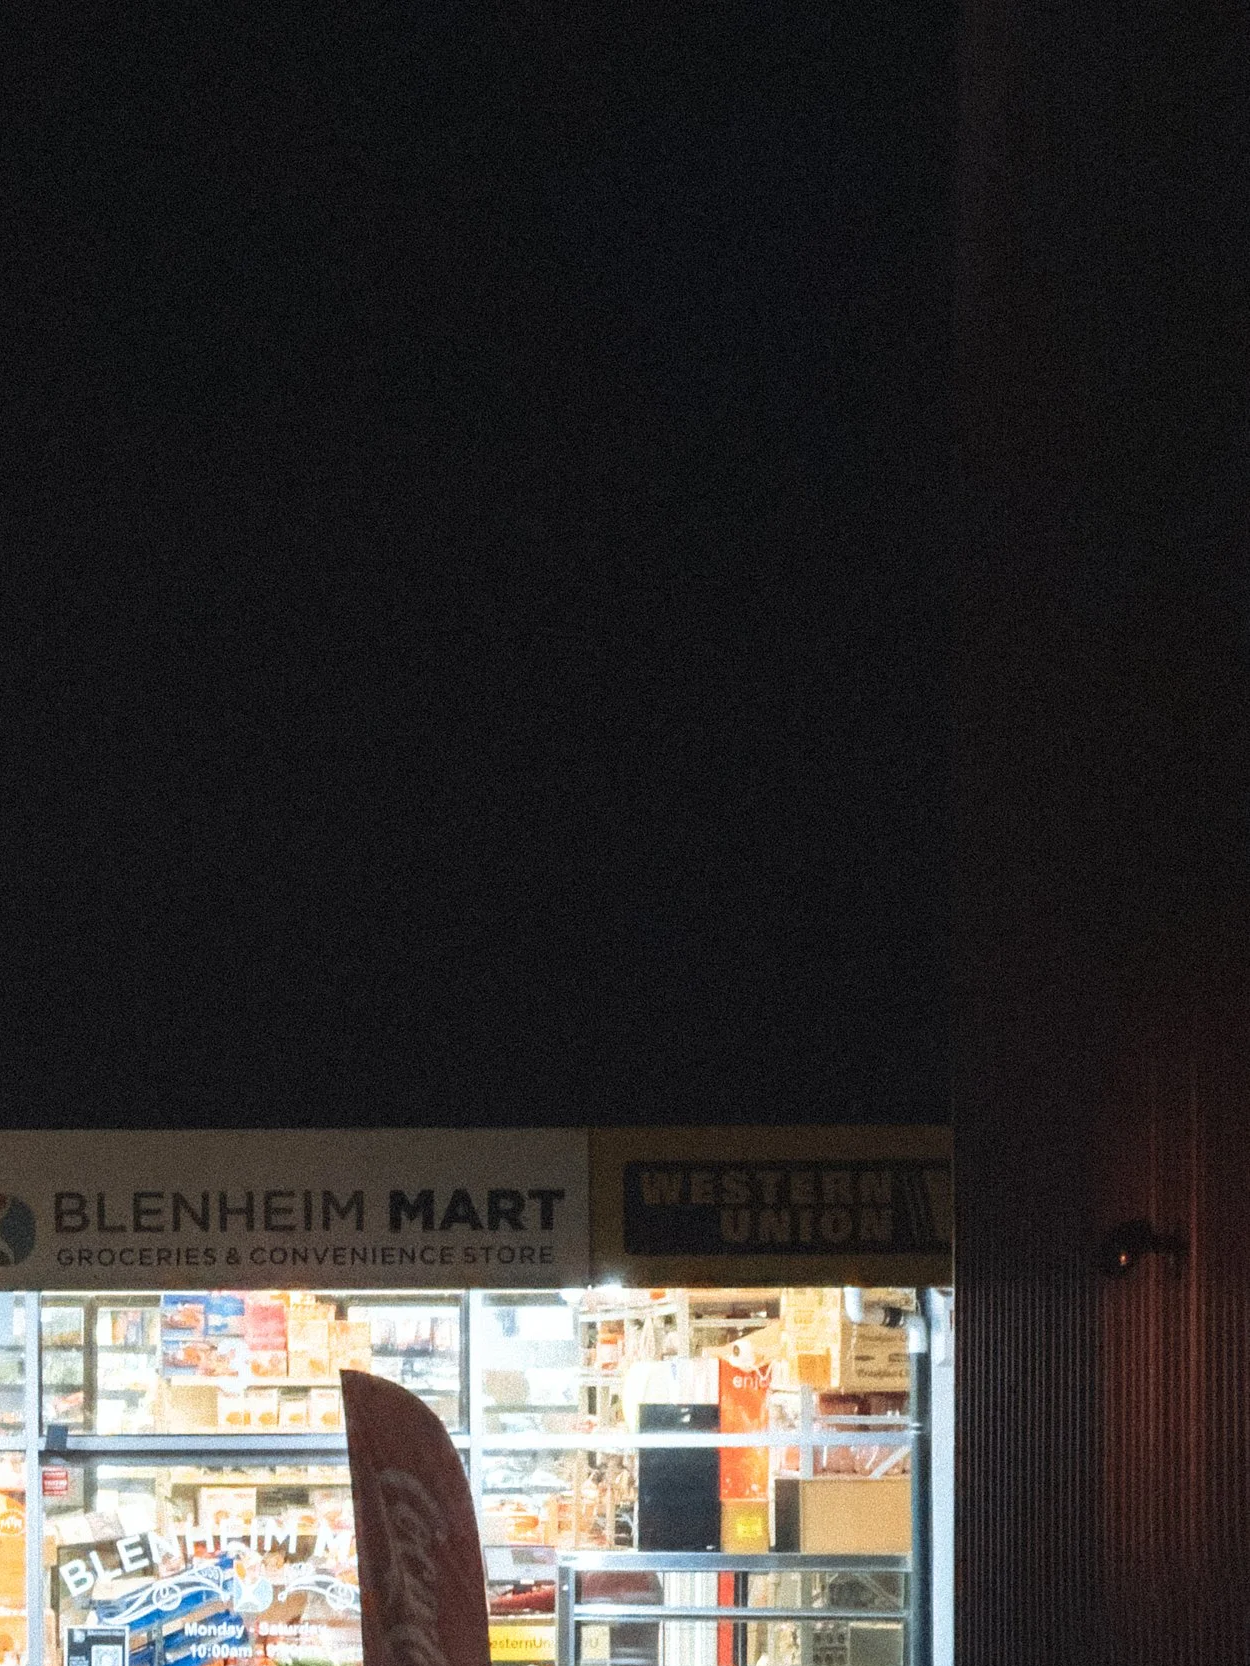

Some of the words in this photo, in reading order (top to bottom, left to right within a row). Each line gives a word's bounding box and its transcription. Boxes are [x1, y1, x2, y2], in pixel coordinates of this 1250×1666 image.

[641, 1170, 892, 1206] WESTERN
[53, 1189, 365, 1233] BLENHEIM
[387, 1188, 565, 1232] MART
[720, 1207, 893, 1243] UNION
[56, 1245, 218, 1266] GROCERIES
[225, 1246, 242, 1265] &
[249, 1245, 455, 1266] CONVENIENCE
[463, 1244, 555, 1265] STORE
[59, 1517, 298, 1597] BLENHEIM
[184, 1622, 245, 1639] Monday
[189, 1643, 253, 1658] 10:00am
